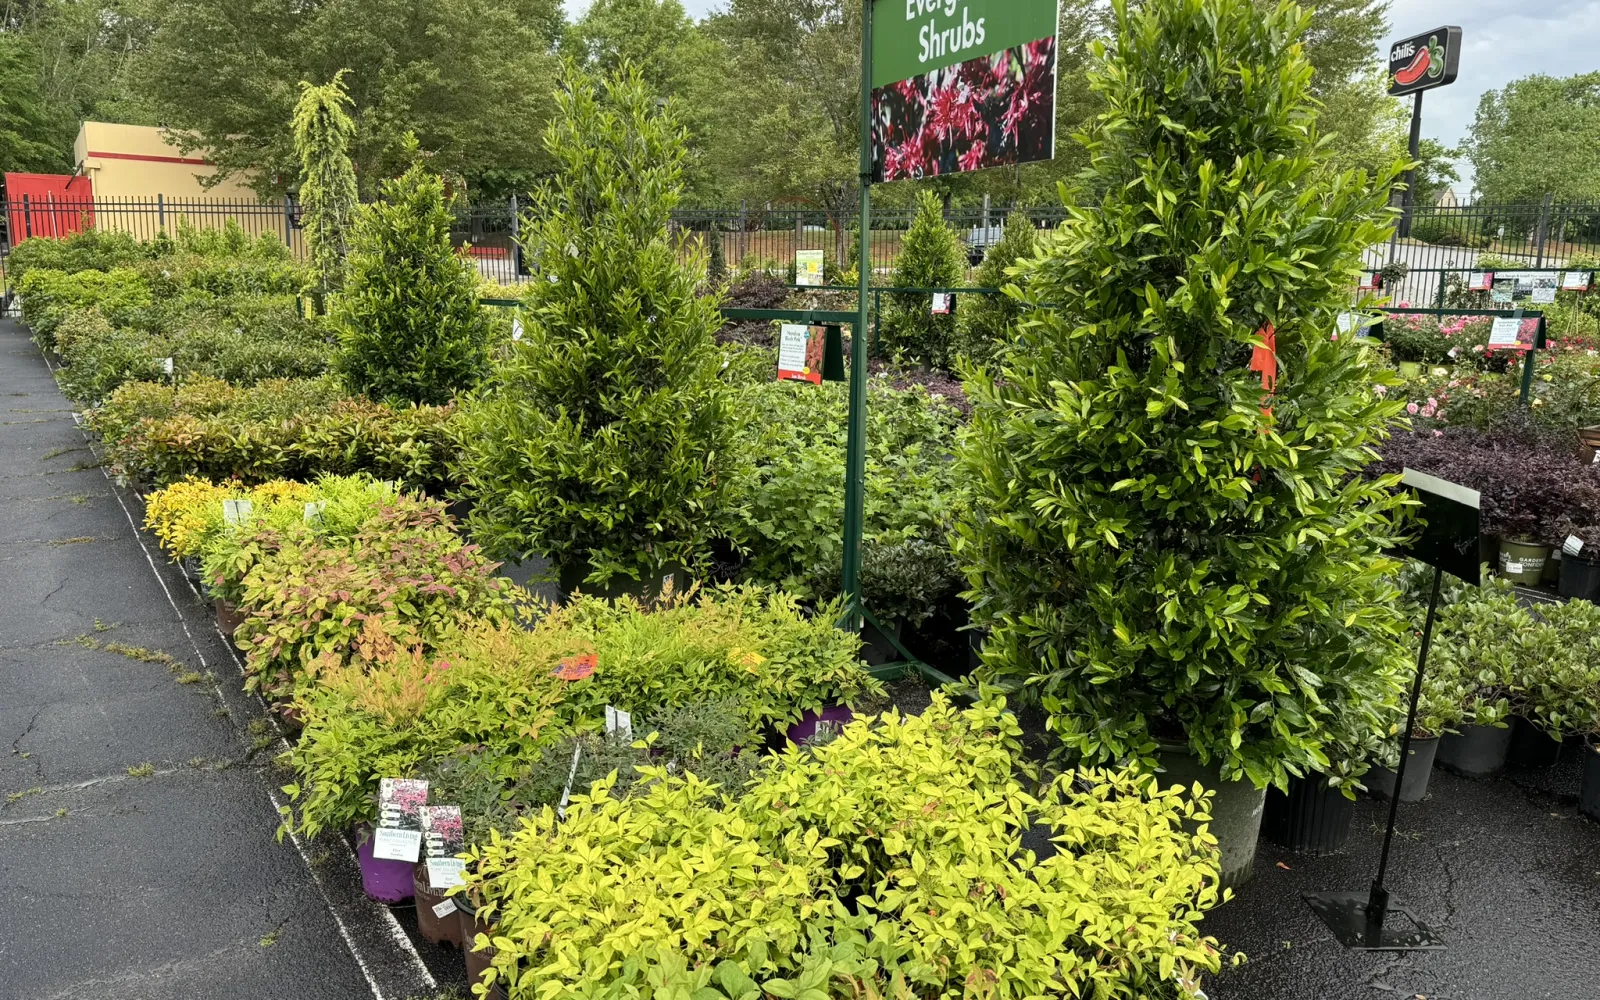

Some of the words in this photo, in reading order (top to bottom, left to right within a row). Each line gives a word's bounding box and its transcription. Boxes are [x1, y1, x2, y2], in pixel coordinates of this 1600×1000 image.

[918, 6, 985, 63] Shrubs
[379, 830, 403, 839] Southern
[403, 831, 418, 841] Living
[430, 859, 450, 867] Southern
[450, 860, 463, 869] Living
